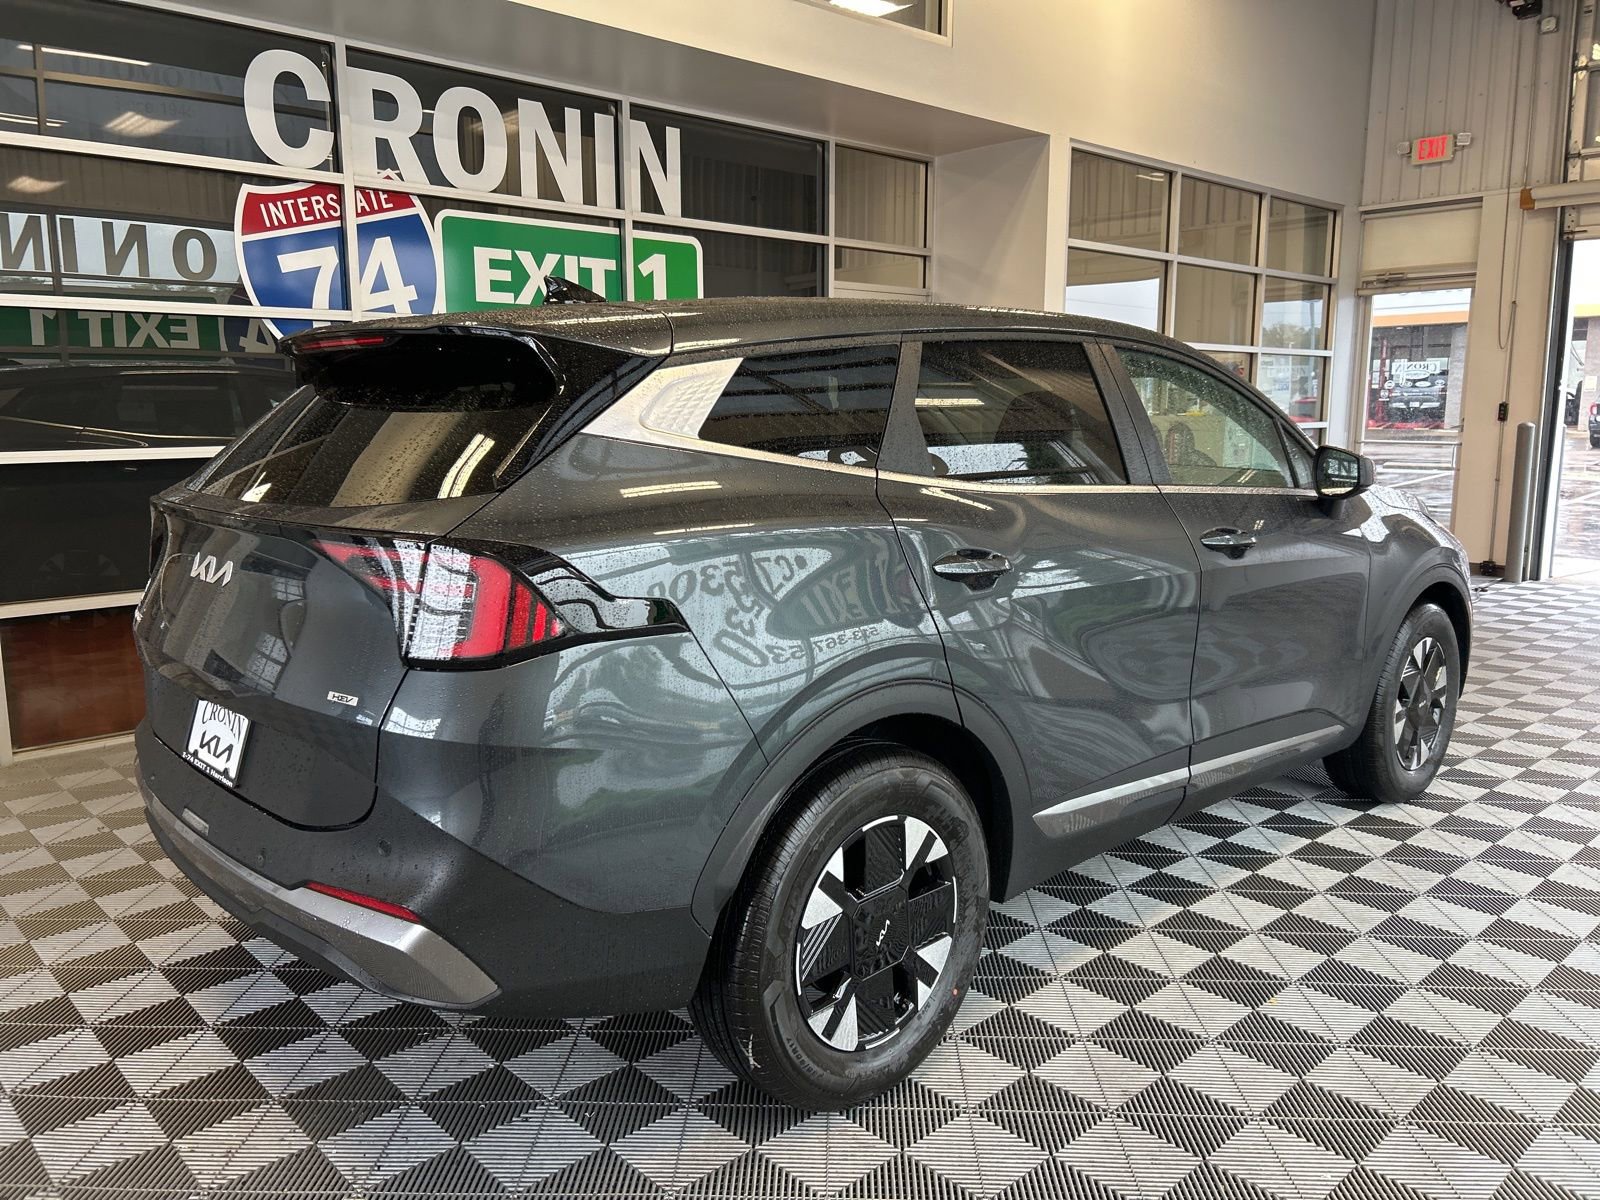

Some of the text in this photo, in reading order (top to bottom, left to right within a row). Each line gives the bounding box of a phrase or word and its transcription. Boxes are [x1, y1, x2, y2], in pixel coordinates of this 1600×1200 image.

[244, 49, 681, 217] CRONIN
[1418, 135, 1448, 160] EXIT
[260, 188, 393, 228] INTERSATE
[277, 235, 419, 327] 74
[473, 247, 667, 305] EXIT 1
[190, 552, 233, 587] KIA
[331, 693, 353, 703] HEV
[202, 701, 245, 742] CRONIN
[199, 731, 233, 764] KIA
[194, 758, 207, 771] EXIT
[210, 769, 233, 788] Harrison
